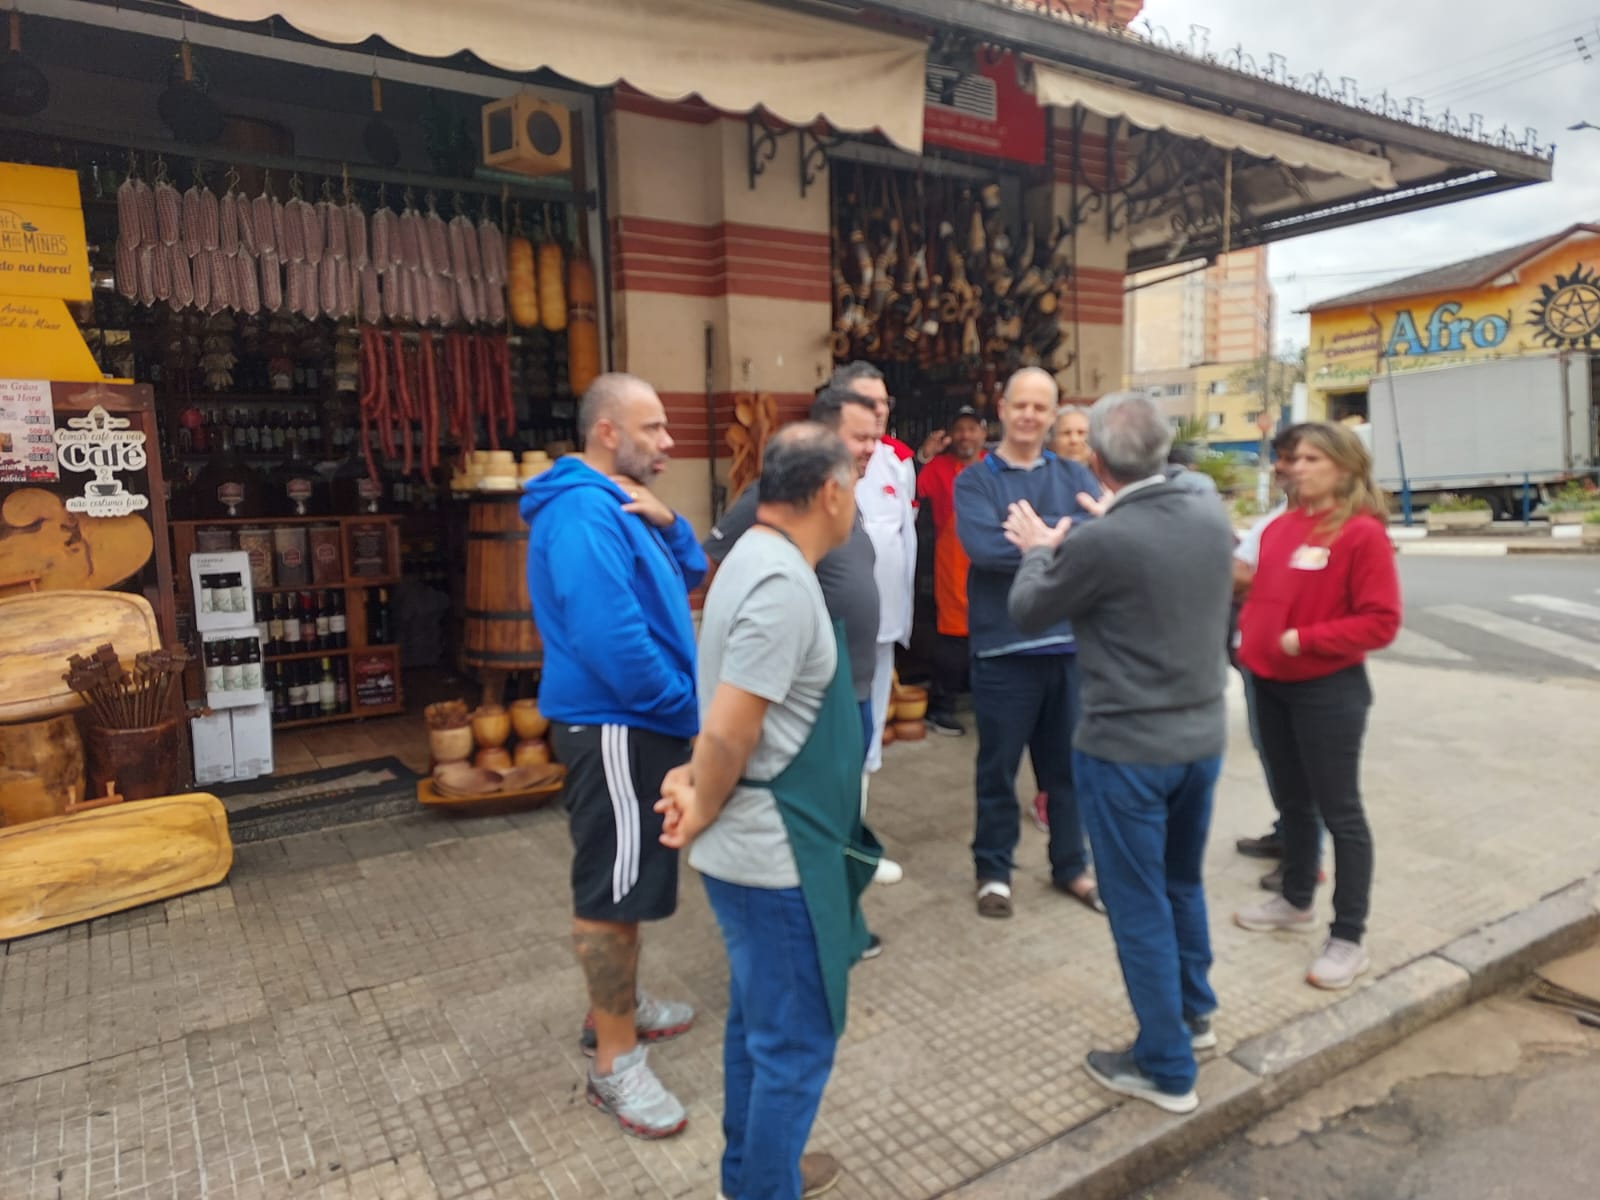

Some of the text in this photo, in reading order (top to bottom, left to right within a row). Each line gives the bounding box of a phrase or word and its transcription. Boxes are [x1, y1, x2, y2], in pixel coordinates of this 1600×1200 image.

[23, 232, 68, 254] MINAS
[18, 262, 35, 273] na
[38, 262, 72, 274] hora!
[1384, 302, 1509, 357] Afro
[17, 393, 42, 402] Hora
